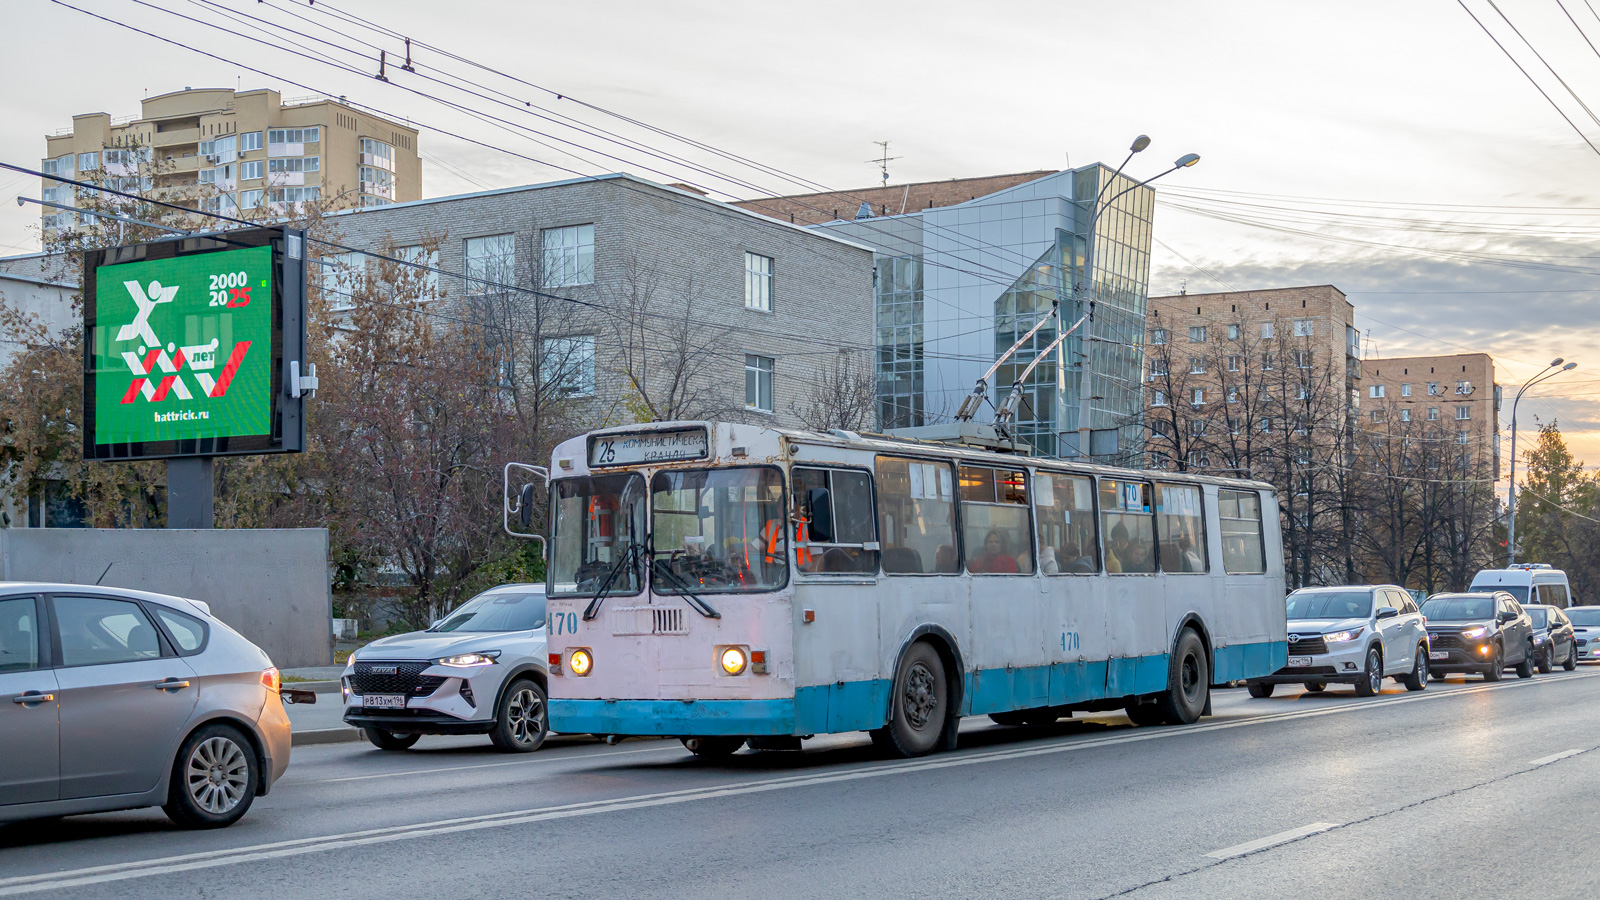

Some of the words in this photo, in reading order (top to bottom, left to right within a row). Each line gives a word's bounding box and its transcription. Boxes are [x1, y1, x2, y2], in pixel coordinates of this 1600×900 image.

[209, 271, 247, 290] 2000
[209, 287, 252, 308] 2025
[192, 352, 214, 362] лет
[154, 410, 210, 422] hattrick.ru
[622, 434, 706, 449] КОММУНИСТИЧЕСКА
[599, 440, 615, 463] 26
[1122, 484, 1137, 501] 70
[1060, 632, 1080, 652] 470
